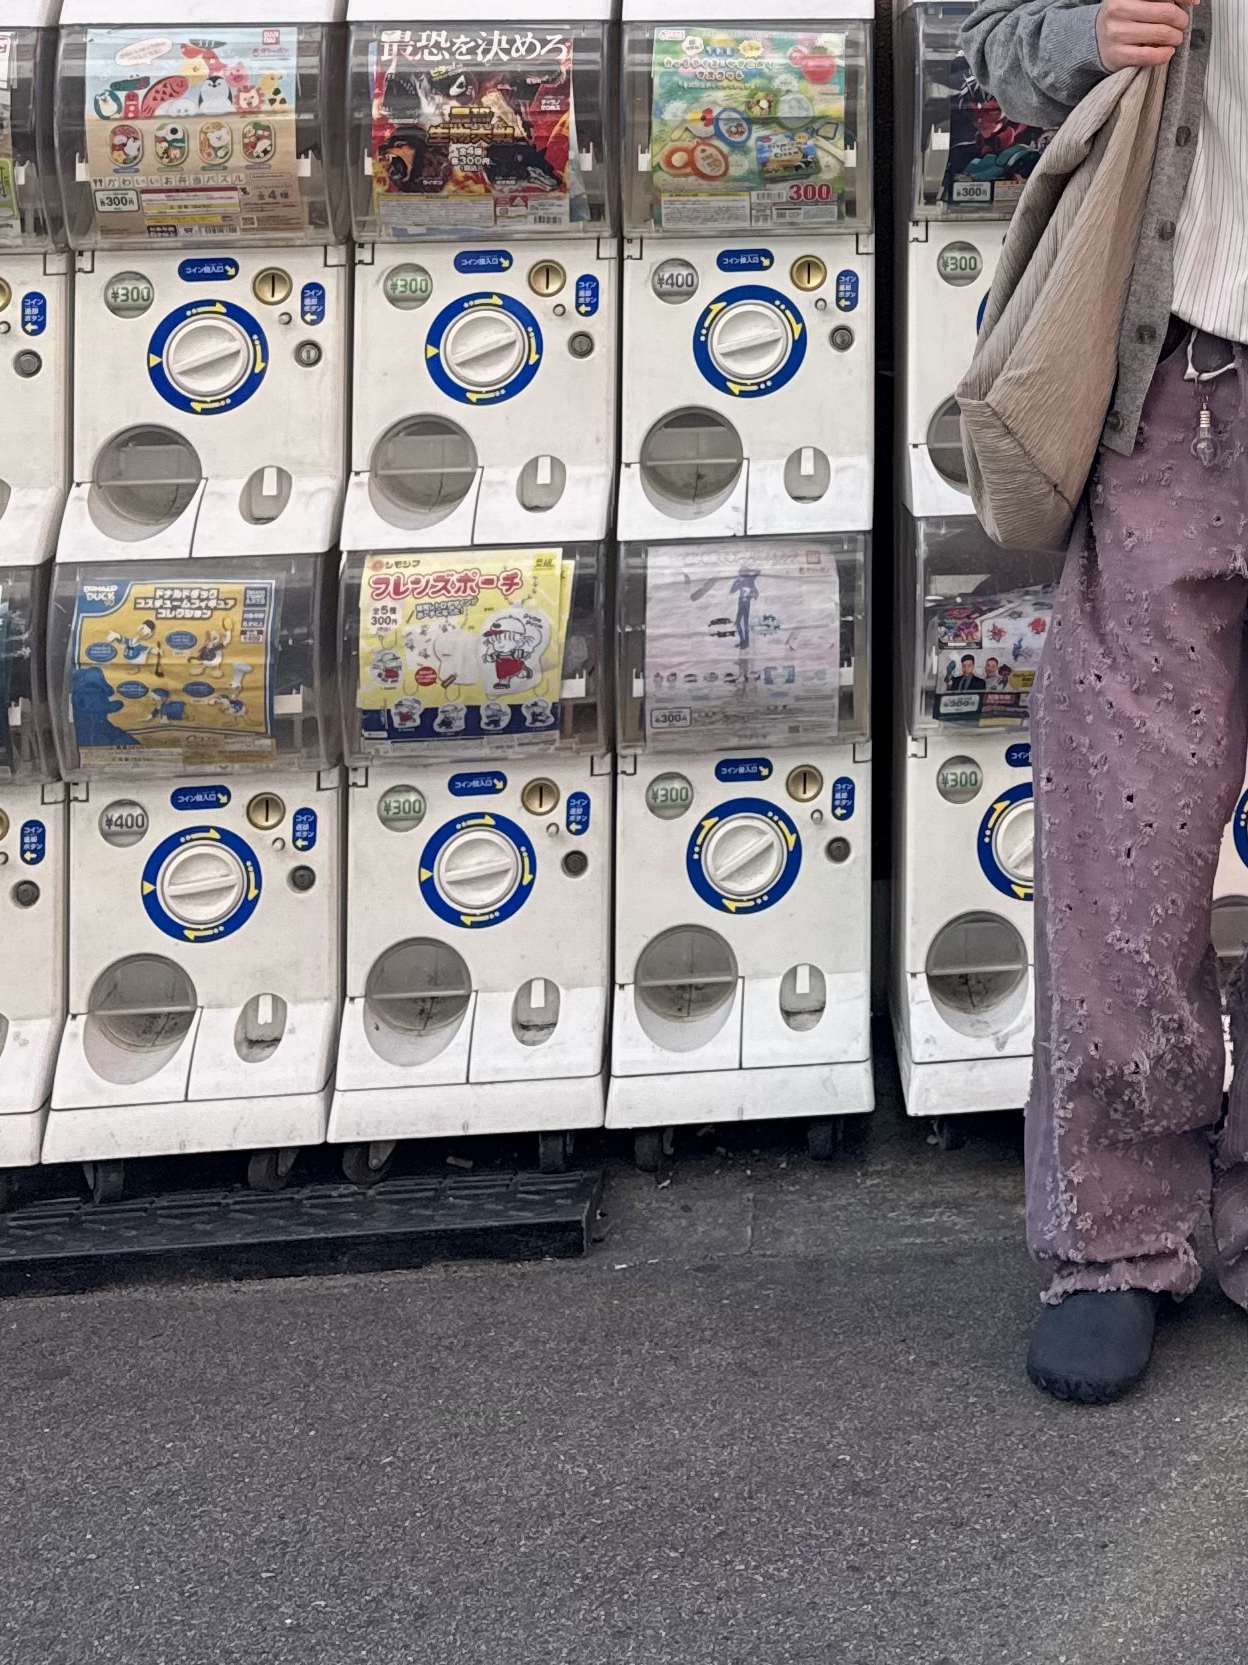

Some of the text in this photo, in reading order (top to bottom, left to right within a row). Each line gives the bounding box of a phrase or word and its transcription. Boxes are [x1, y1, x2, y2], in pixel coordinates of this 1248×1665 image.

[381, 30, 570, 62] 最恐を決めろ
[941, 255, 978, 272] ¥300
[390, 278, 429, 294] ¥300
[656, 272, 695, 288] ¥400
[110, 287, 151, 304] ¥300
[370, 569, 521, 599] フレンズポーチ
[87, 591, 116, 601] DUCK
[371, 616, 397, 626] 300円
[941, 770, 978, 787] ¥300
[651, 787, 689, 804] ¥300
[383, 798, 422, 815] ¥300
[105, 813, 145, 829] ¥400
